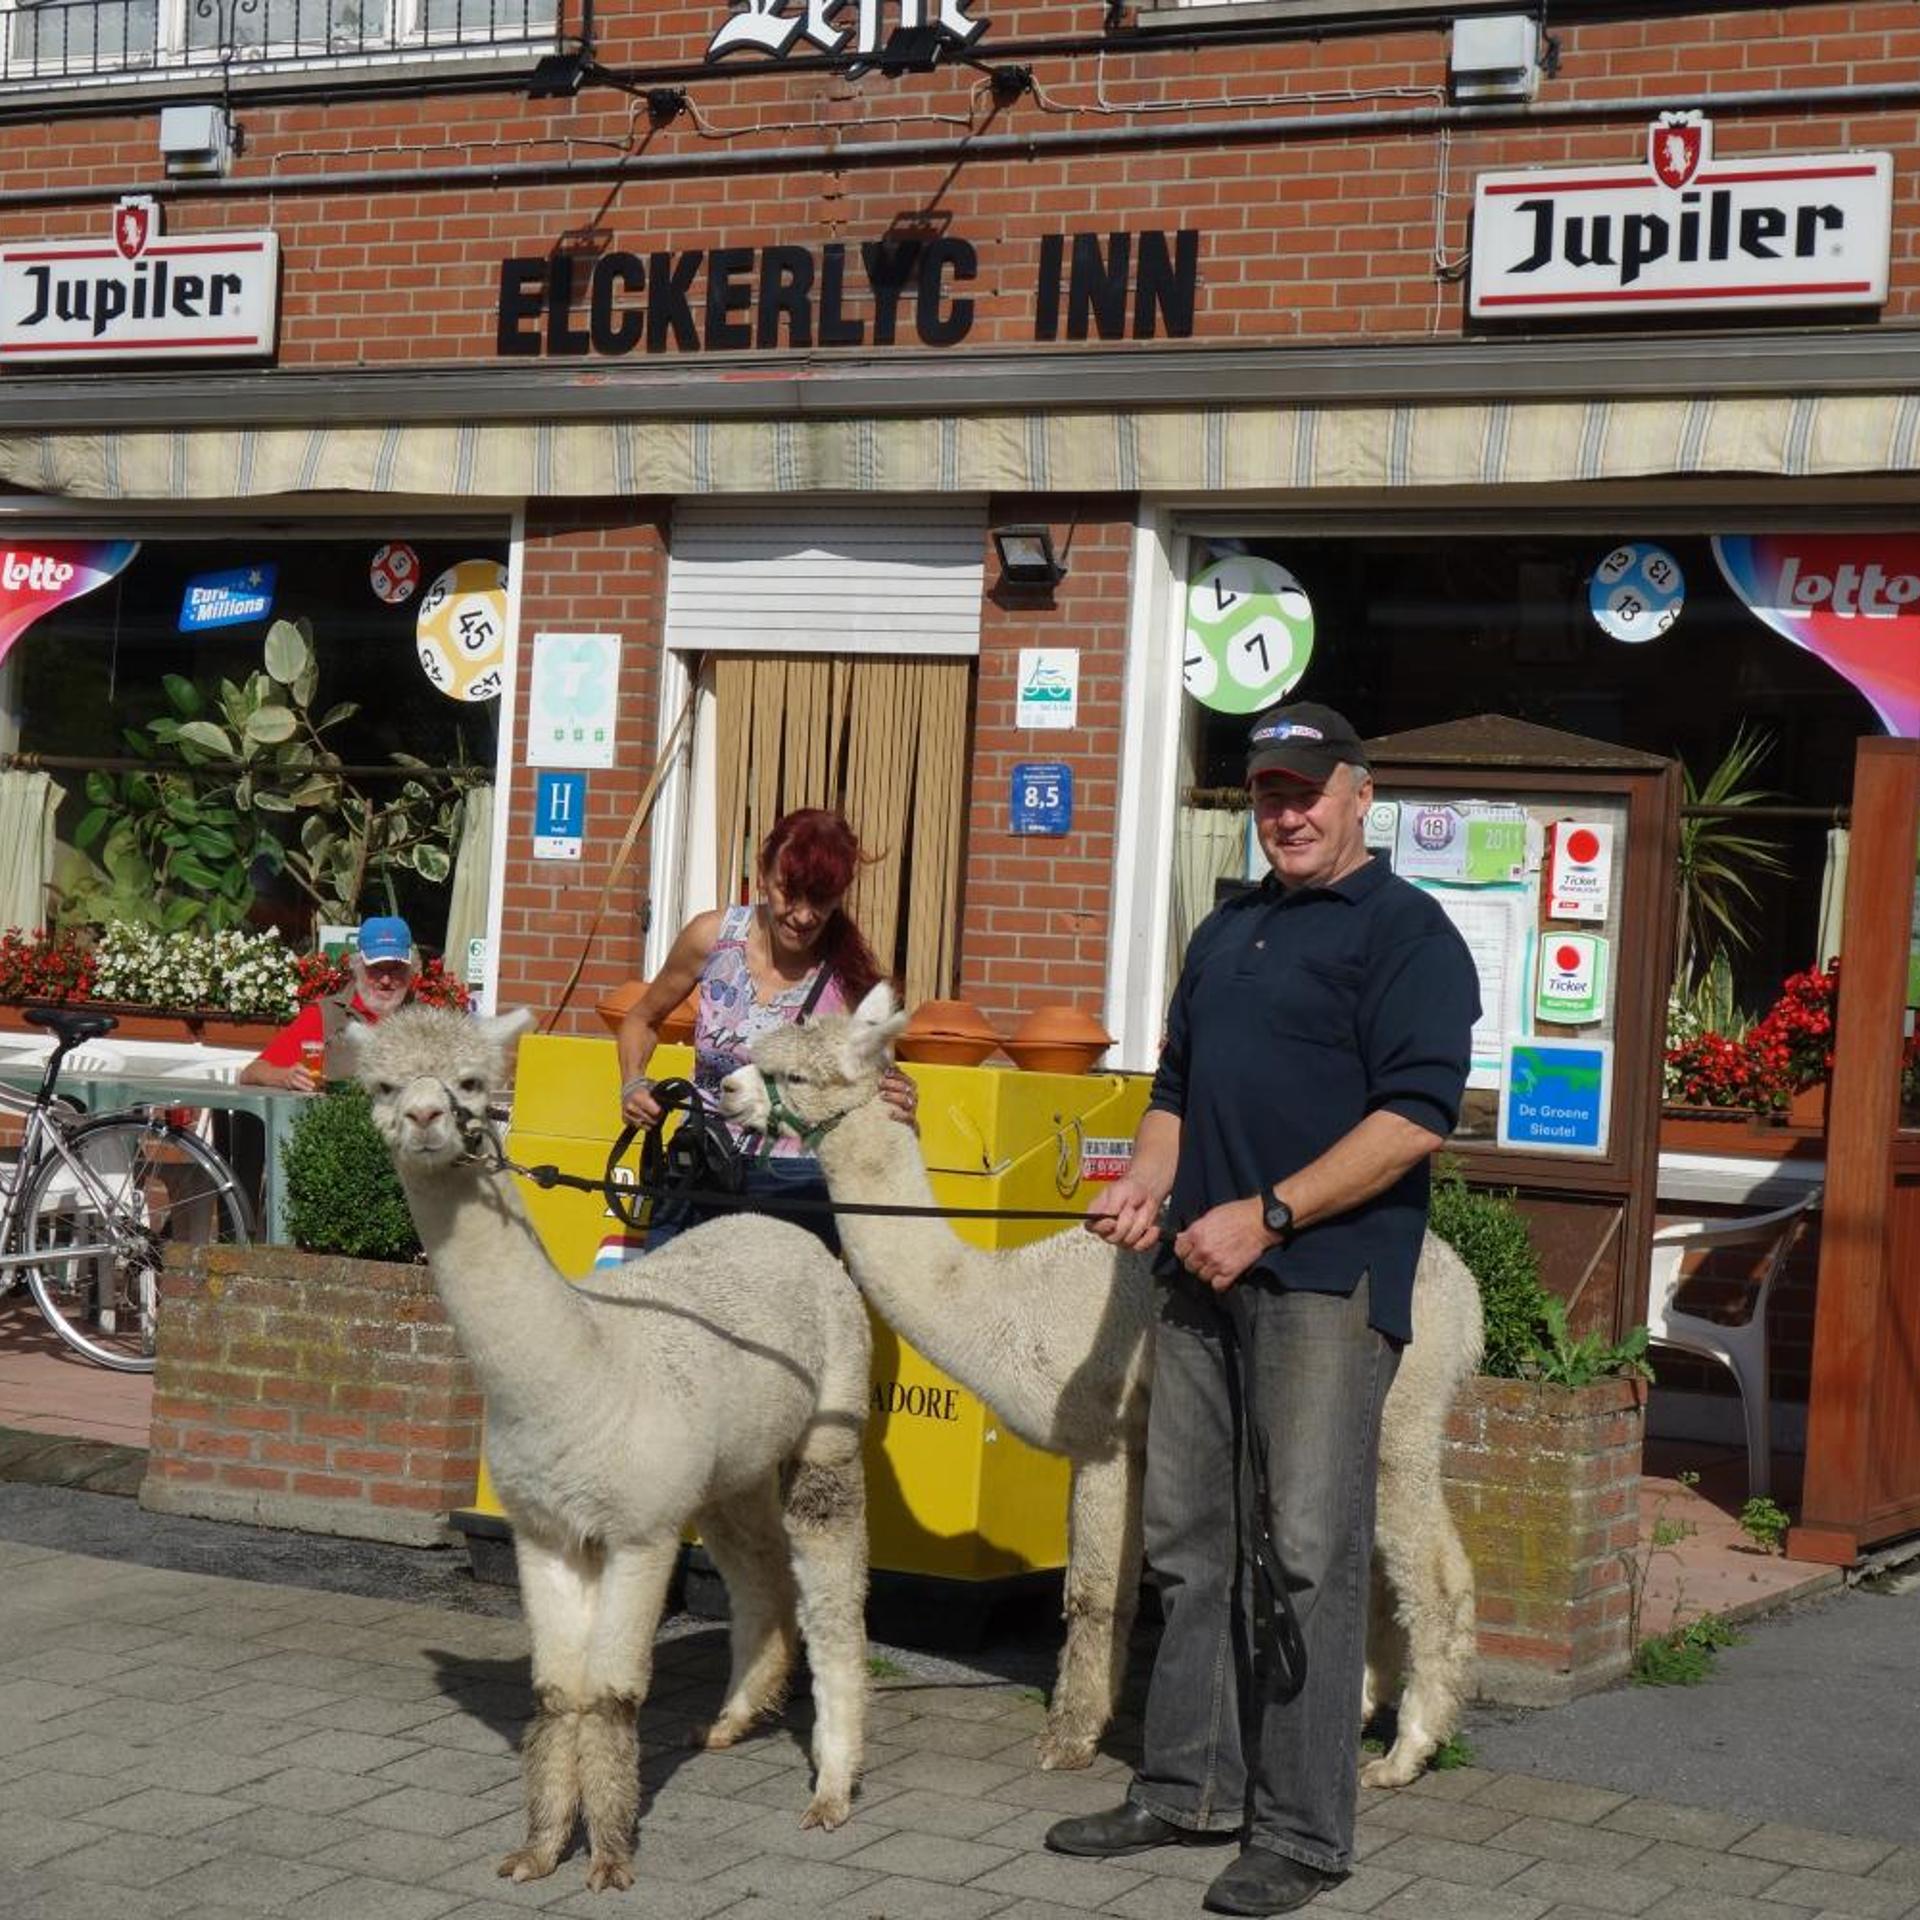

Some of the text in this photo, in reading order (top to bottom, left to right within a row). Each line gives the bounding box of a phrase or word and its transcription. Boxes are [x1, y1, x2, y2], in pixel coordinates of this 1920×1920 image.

[1505, 189, 1845, 286] Jupiler
[18, 260, 243, 337] Jupiler
[497, 229, 1199, 357] ELCKERLYC INN
[2, 552, 74, 591] lotto
[1604, 552, 1629, 573] 13
[191, 586, 228, 605] Euro
[1777, 557, 1920, 619] lotto
[197, 597, 265, 621] Millions
[1616, 594, 1642, 621] 13
[459, 610, 493, 650] 45
[1244, 633, 1270, 671] 7
[550, 783, 572, 821] H
[1024, 786, 1060, 809] 8,5
[1424, 819, 1444, 837] 18
[1564, 874, 1598, 887] Ticket
[1549, 978, 1588, 993] Ticket
[1519, 1103, 1590, 1120] De Groene
[1530, 1122, 1577, 1138] Sleutel
